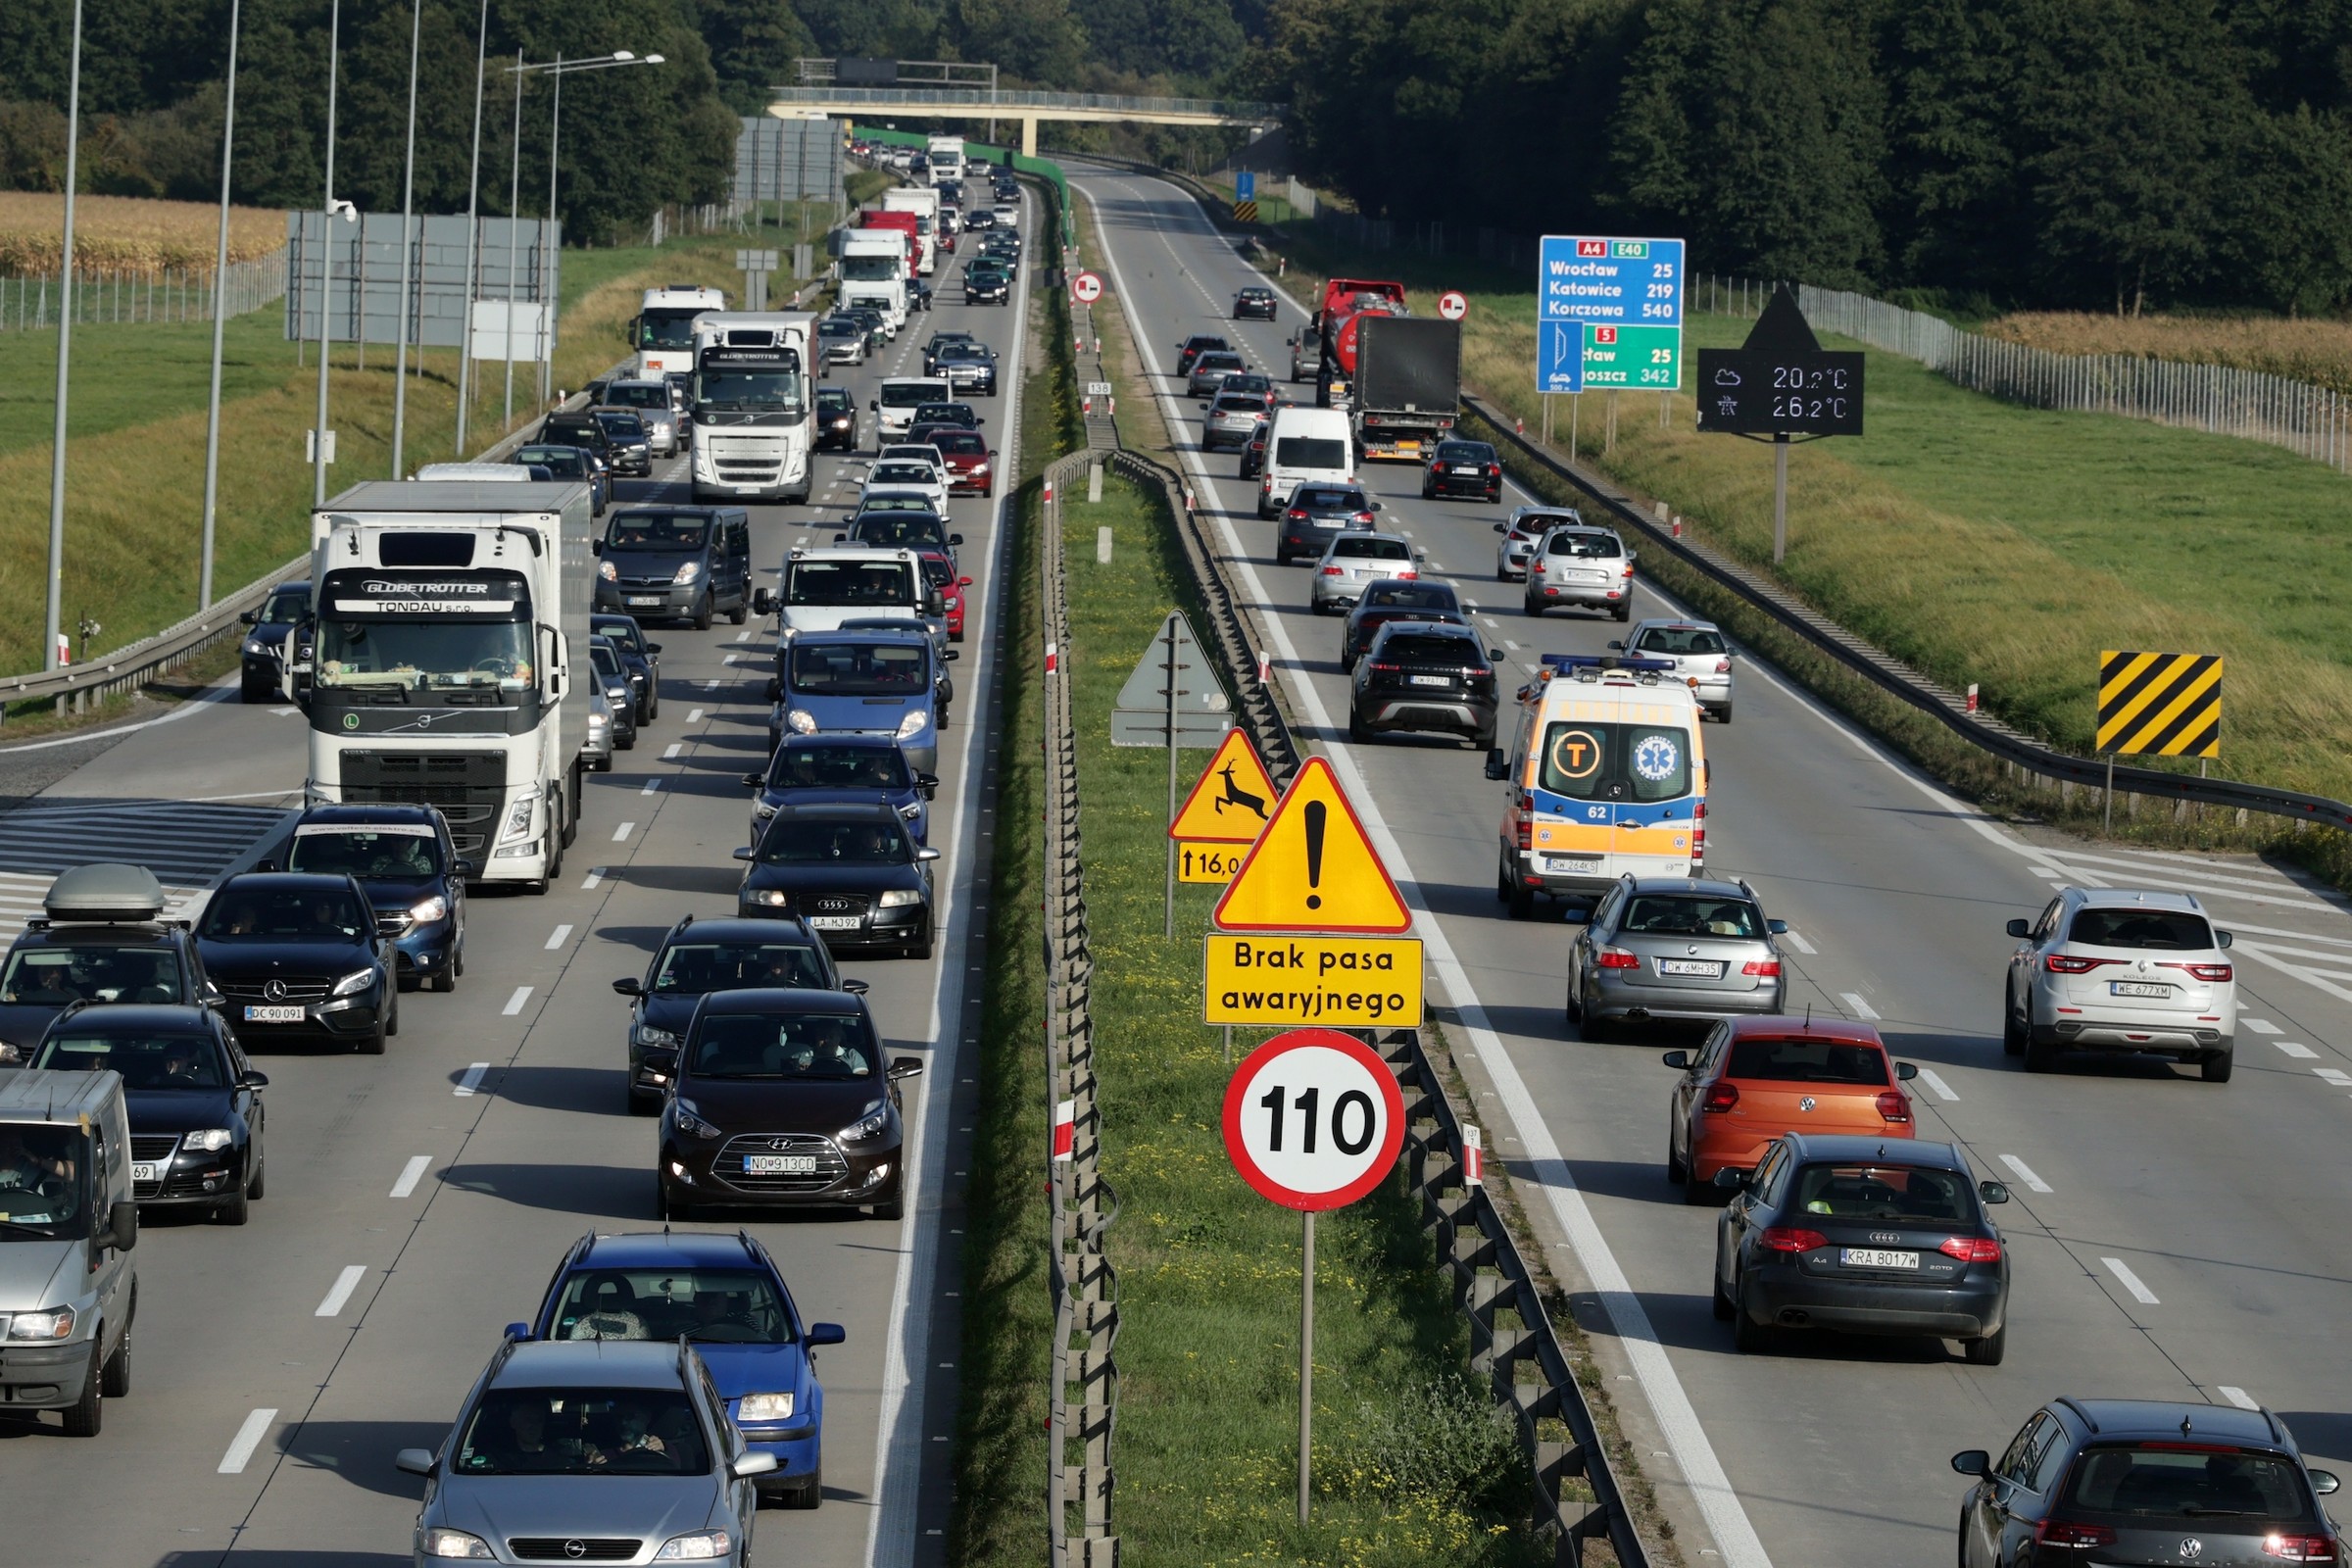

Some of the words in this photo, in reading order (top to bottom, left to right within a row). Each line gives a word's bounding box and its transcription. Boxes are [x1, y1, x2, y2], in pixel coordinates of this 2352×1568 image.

[1583, 243, 1601, 255] A4
[1618, 244, 1642, 256] E40
[1549, 261, 1618, 277] Wrocław
[1653, 264, 1673, 278] 25
[1549, 281, 1622, 297] Katowice
[1646, 284, 1673, 299] 219
[1549, 301, 1623, 317] Korczowa
[1642, 303, 1673, 318] 540
[1602, 329, 1610, 342] 5
[1651, 349, 1671, 364] 25
[1640, 368, 1670, 383] 342
[1091, 383, 1109, 393] 138
[366, 582, 488, 594] GLOBETROTTER
[376, 602, 442, 612] TONDAU
[446, 603, 474, 613] s.r.o.
[1566, 743, 1587, 767] T
[1588, 806, 1606, 819] 62
[1552, 860, 1565, 869] DW
[1568, 861, 1596, 872] 264KS
[814, 918, 825, 928] LA
[845, 918, 857, 928] 92
[1235, 942, 1305, 968] Brak
[1319, 951, 1393, 977] pasa
[1667, 962, 1681, 973] DW
[1685, 963, 1716, 974] 6MH35
[2119, 984, 2132, 993] WE
[2136, 985, 2168, 996] 677XM
[1222, 985, 1405, 1018] awaryjnego
[252, 1009, 266, 1018] DC
[269, 1009, 282, 1019] 90
[284, 1009, 301, 1019] 091
[1261, 1085, 1376, 1156] 110
[752, 1157, 767, 1170] NO
[774, 1158, 814, 1170] 913CD
[134, 1166, 148, 1178] 69
[1848, 1250, 1873, 1264] KRA
[1877, 1252, 1917, 1267] 8017W
